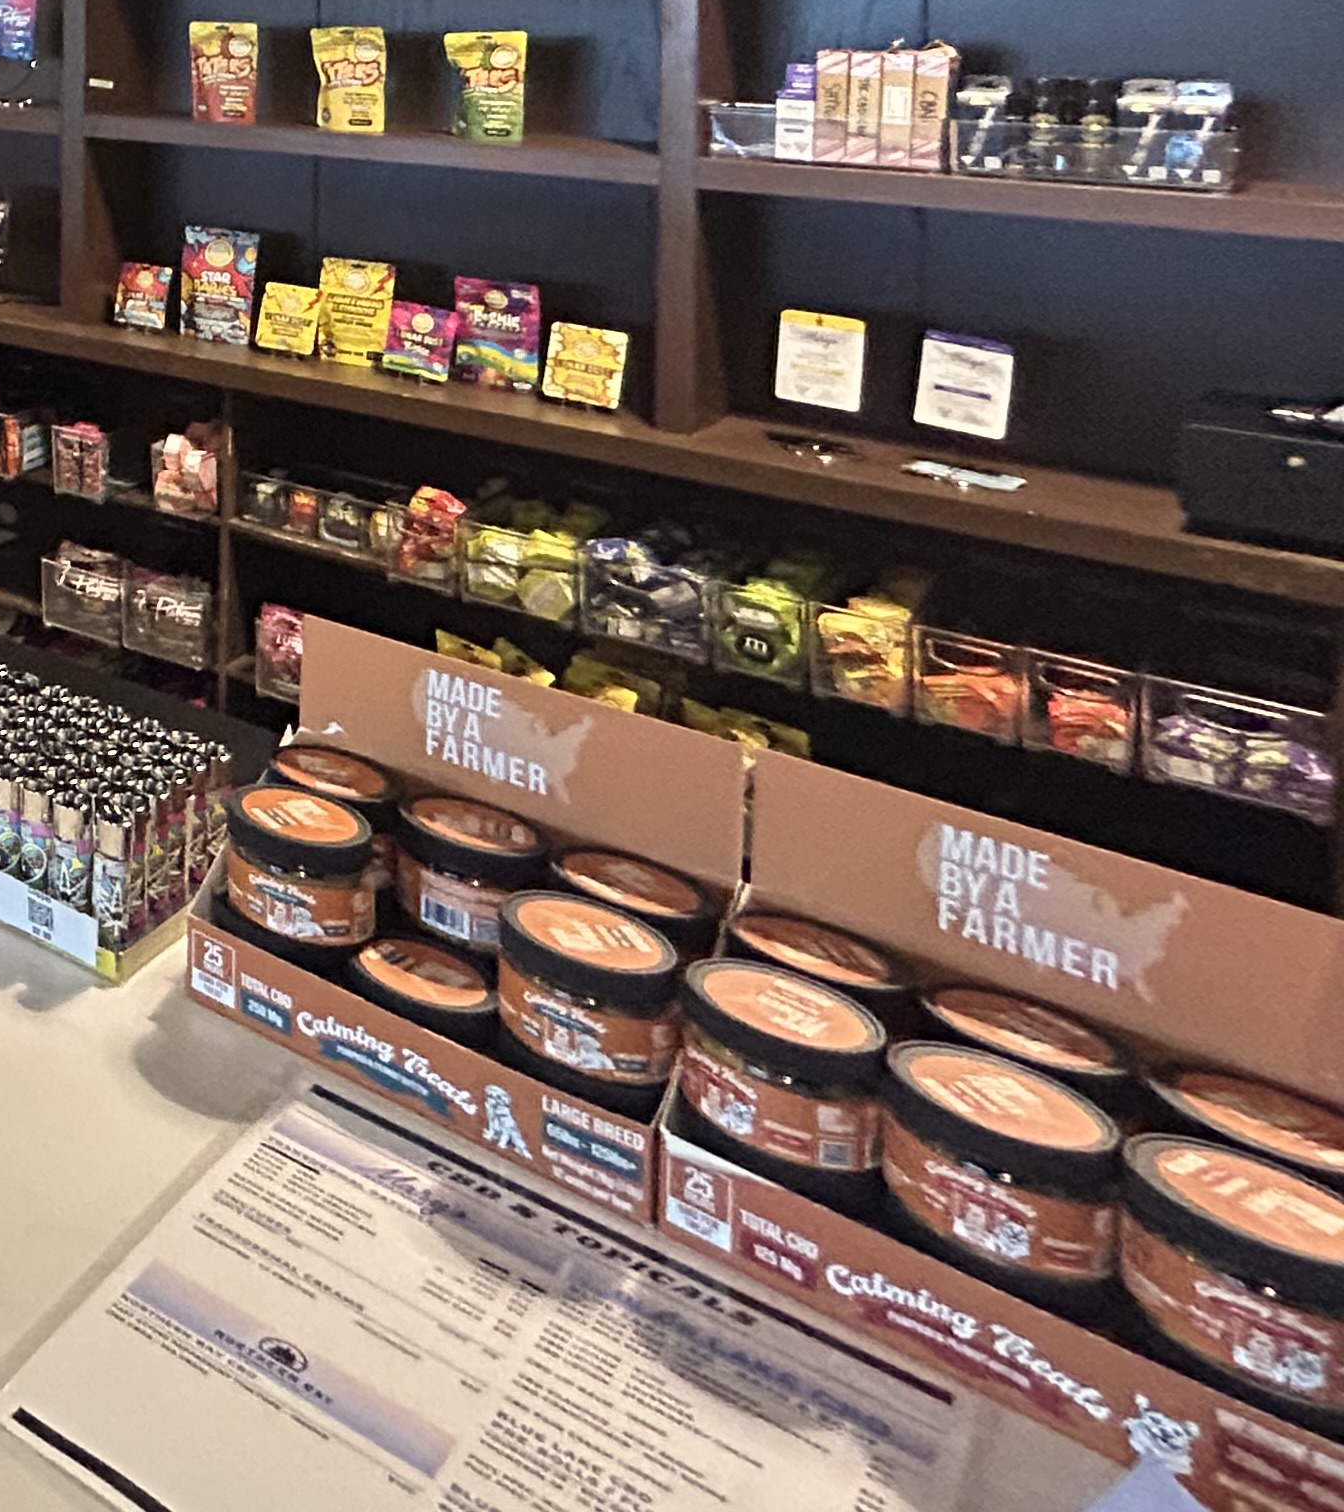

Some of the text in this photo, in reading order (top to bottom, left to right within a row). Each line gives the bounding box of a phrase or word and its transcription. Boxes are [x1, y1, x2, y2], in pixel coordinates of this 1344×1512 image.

[427, 669, 502, 719] MADE
[427, 699, 482, 745] BY A
[426, 727, 547, 795] FARMER
[940, 824, 1051, 890] MADE
[939, 861, 1021, 918] BY A
[203, 940, 223, 968] 25
[938, 896, 1118, 991] FARMER
[240, 972, 293, 1009] TOTAL CBD
[296, 1011, 395, 1063] Calming
[401, 1048, 479, 1116] Treats
[542, 1095, 645, 1152] LARGE BREED
[685, 1166, 714, 1200] 25
[739, 1208, 786, 1245] TOTAL
[786, 1230, 819, 1260] CBD
[548, 1219, 759, 1331] TOPICALS
[825, 1263, 979, 1339] Calming
[989, 1322, 1111, 1421] Treats
